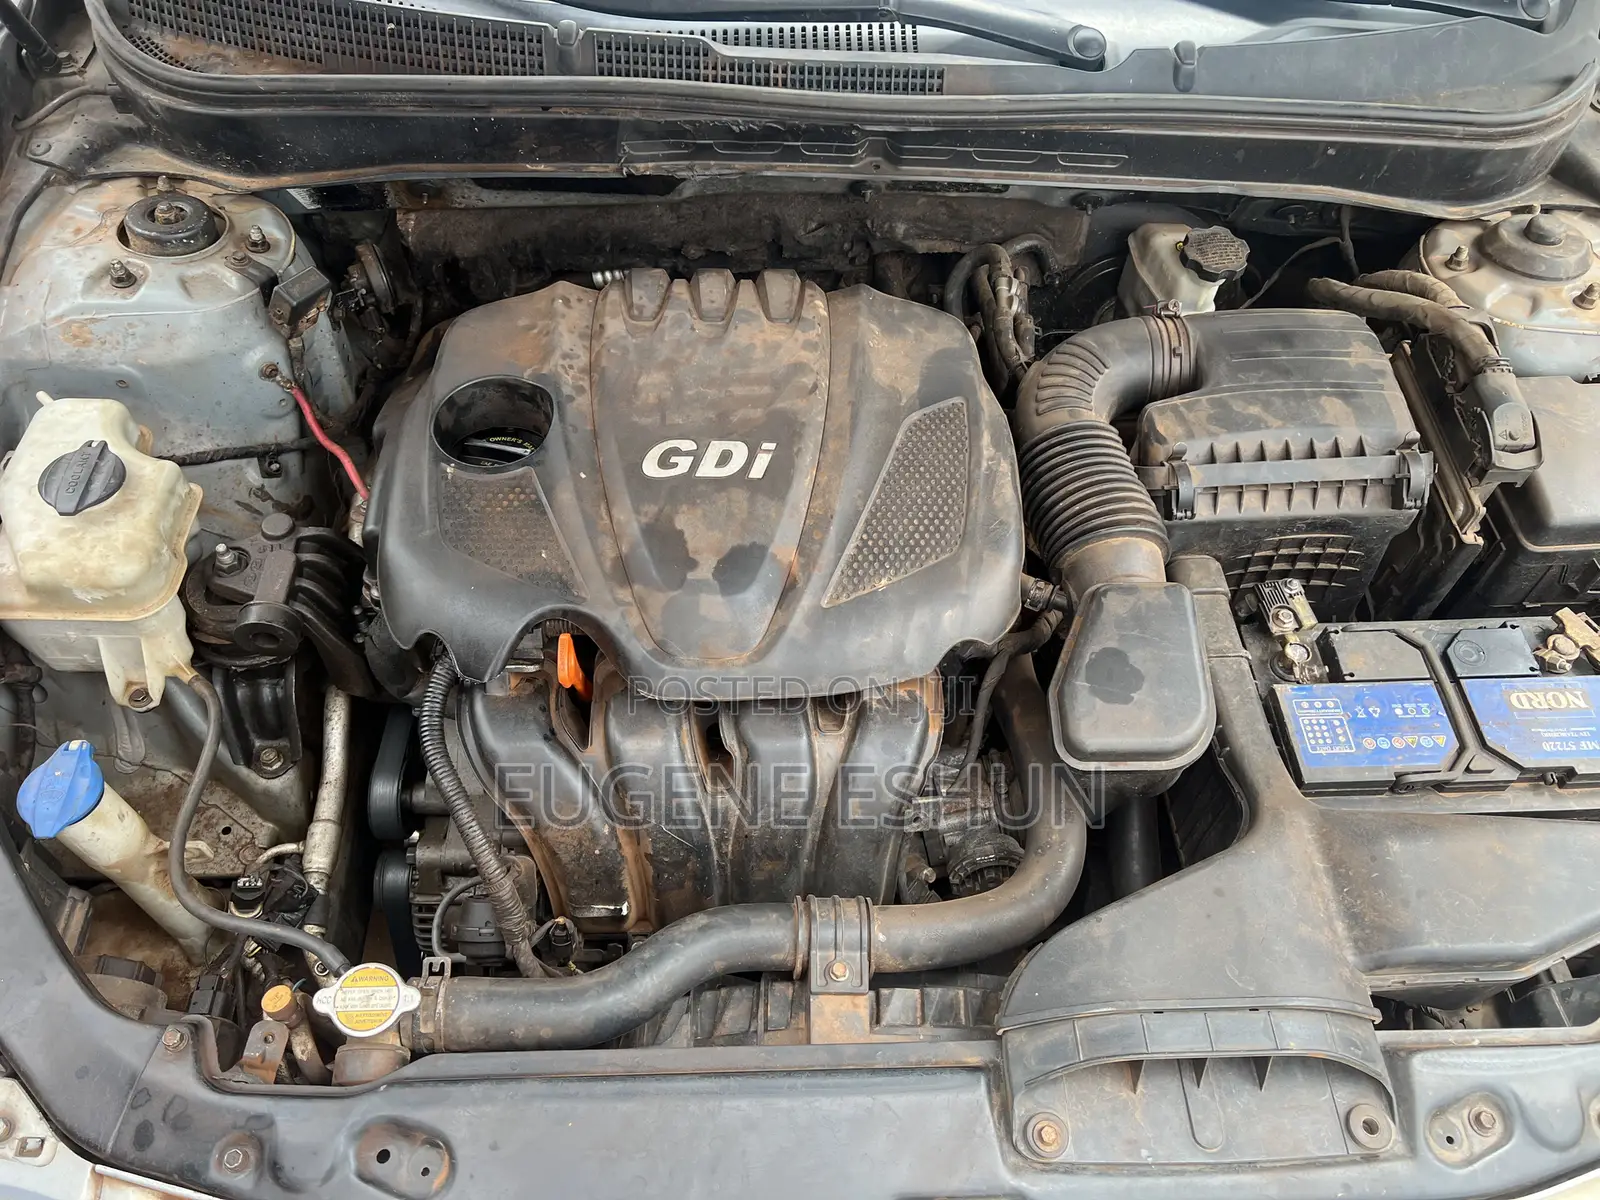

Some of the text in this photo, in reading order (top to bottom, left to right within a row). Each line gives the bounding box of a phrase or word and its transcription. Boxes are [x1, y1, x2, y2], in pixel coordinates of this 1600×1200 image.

[65, 451, 91, 495] COOLANT
[640, 439, 778, 479] GDi
[1510, 691, 1588, 710] NORD
